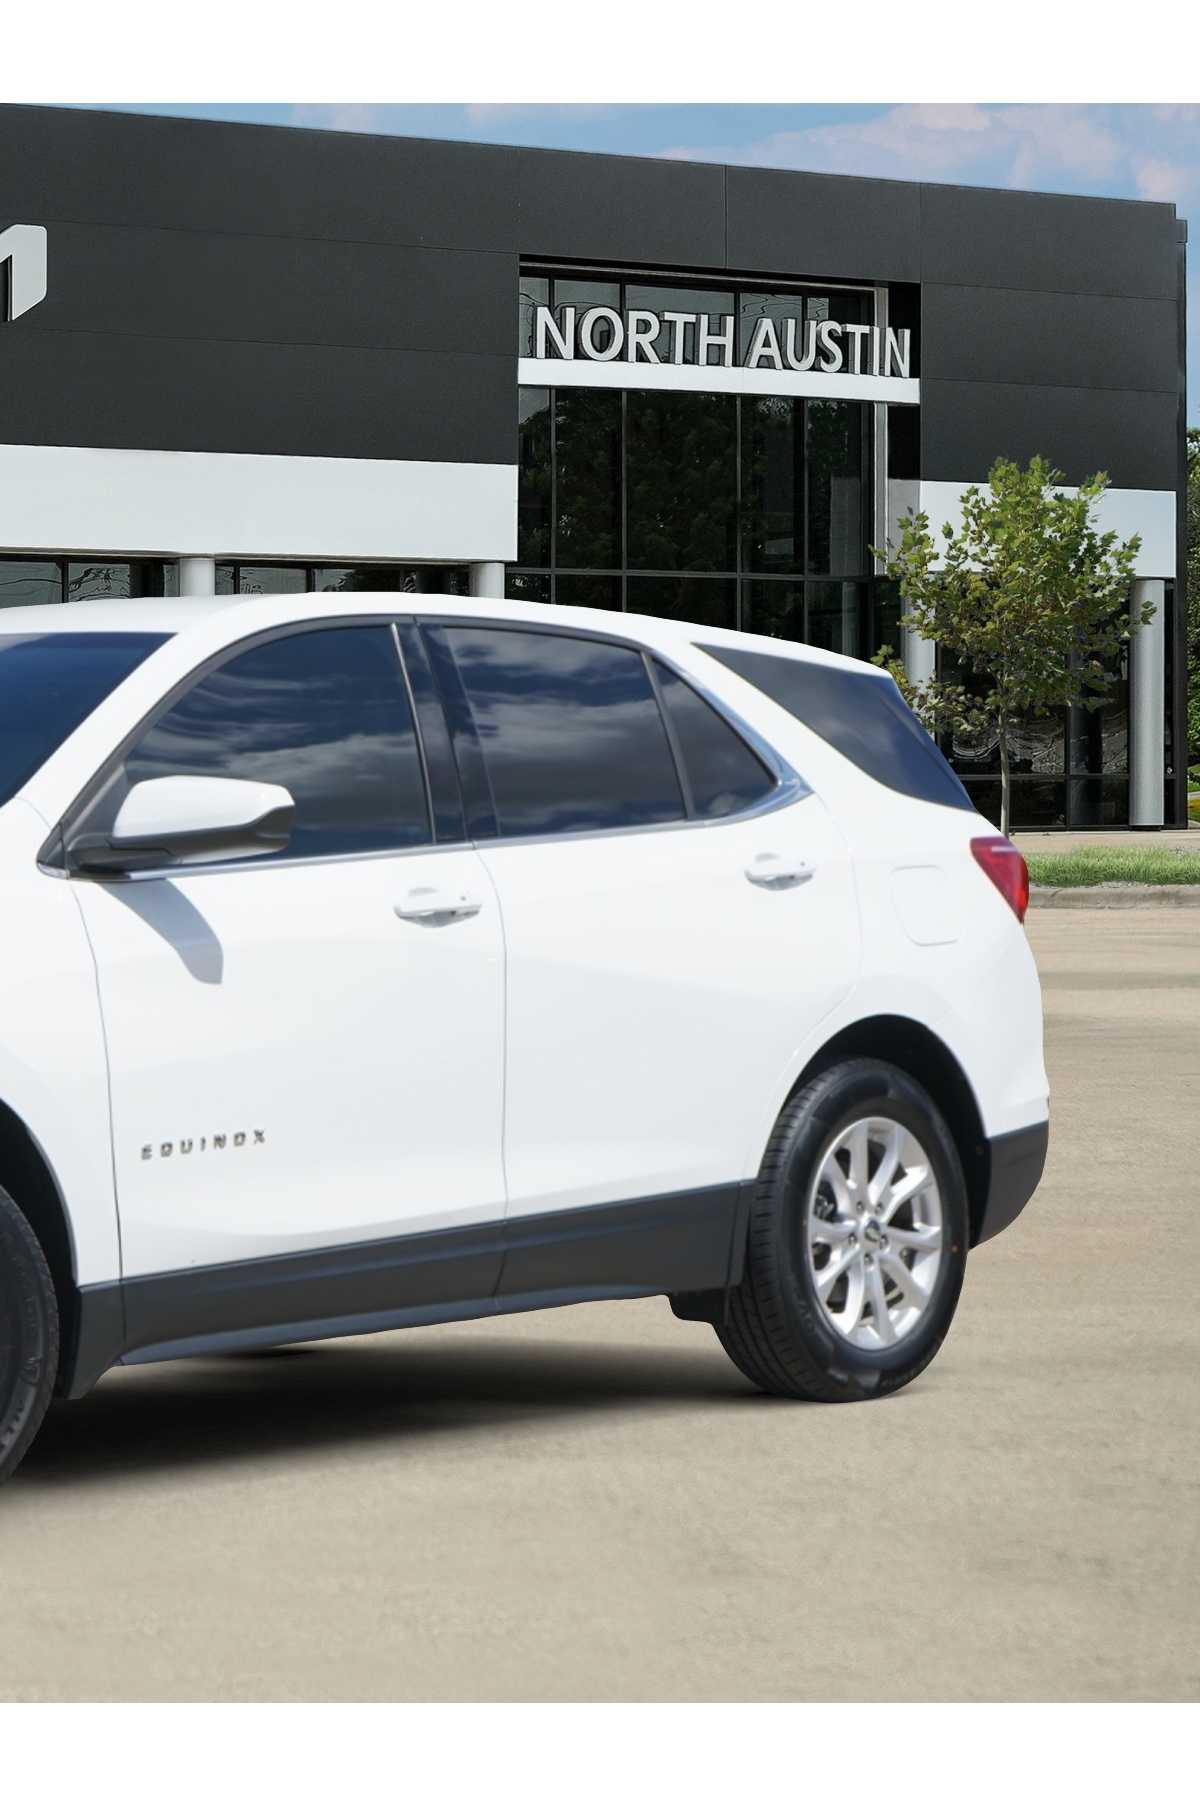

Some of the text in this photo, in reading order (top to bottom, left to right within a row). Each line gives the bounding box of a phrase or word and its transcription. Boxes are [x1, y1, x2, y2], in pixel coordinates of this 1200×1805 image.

[535, 305, 913, 378] NORTH AUSTIN
[141, 1129, 266, 1160] EQUINOX
